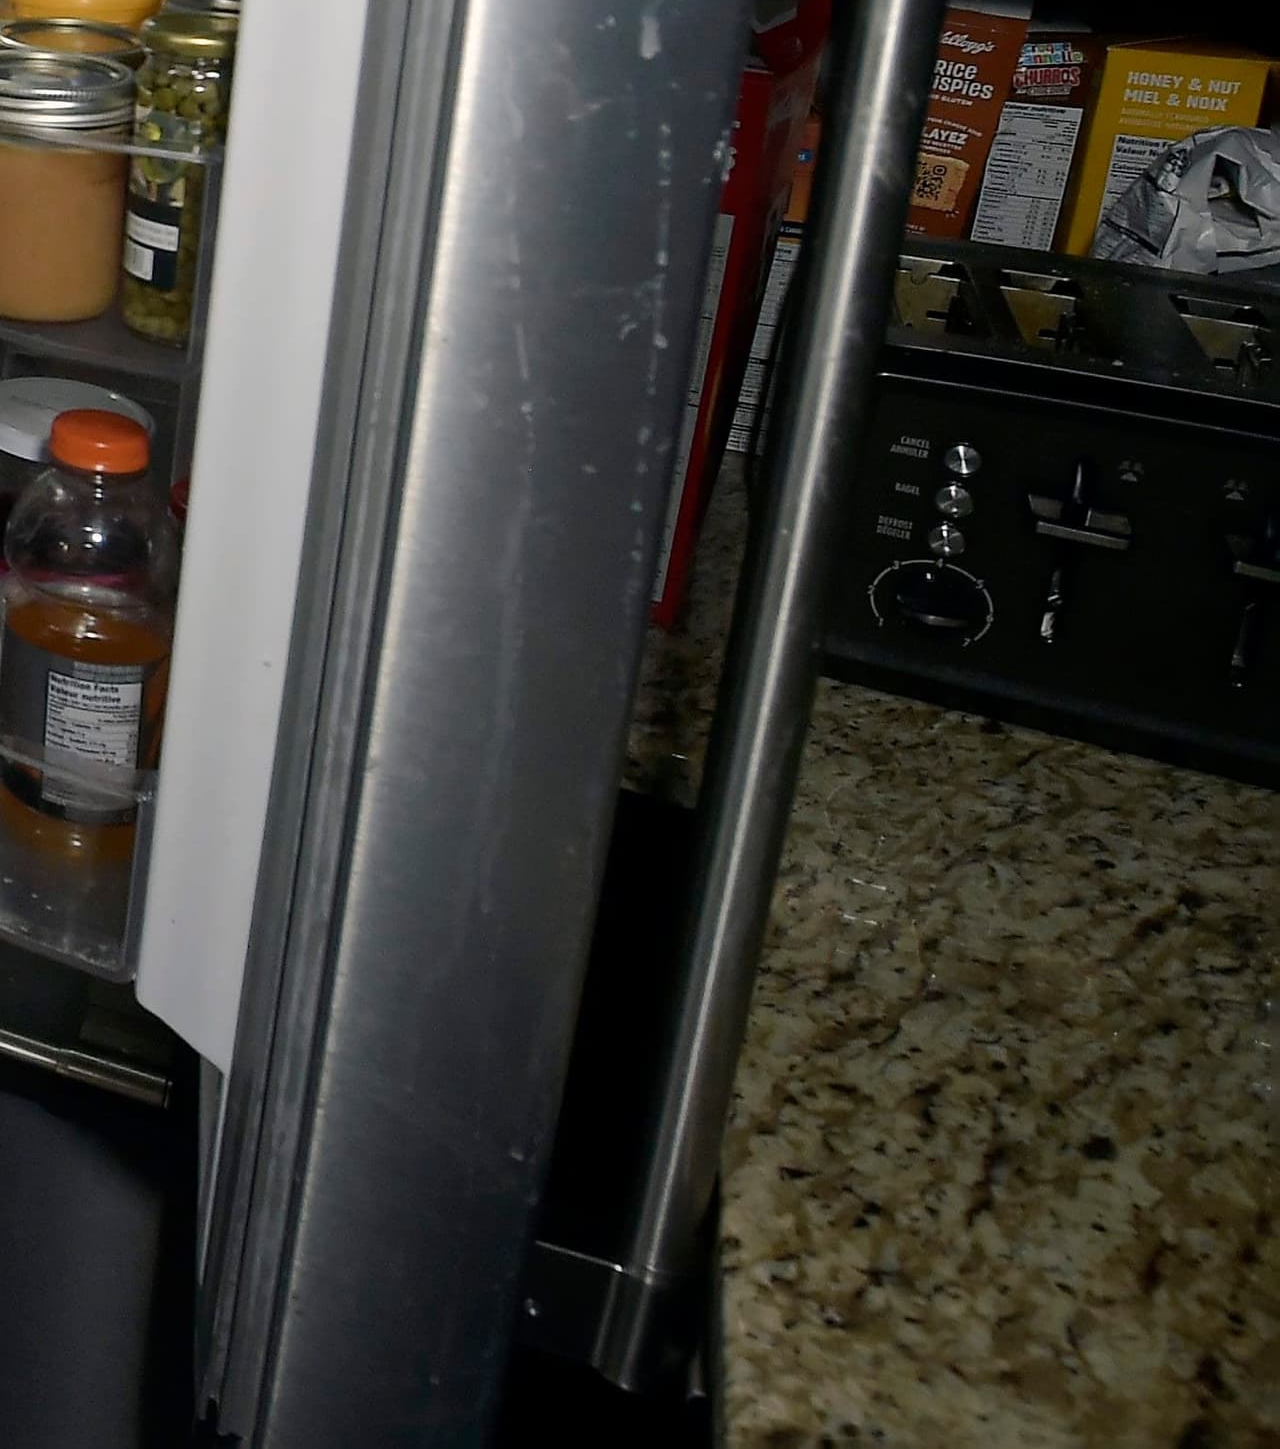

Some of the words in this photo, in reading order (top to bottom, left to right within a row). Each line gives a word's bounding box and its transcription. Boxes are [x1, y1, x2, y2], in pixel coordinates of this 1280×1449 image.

[940, 30, 997, 55] ellogg's
[1018, 51, 1083, 65] annelle
[1126, 70, 1184, 90] HONEY
[1187, 77, 1203, 92] &
[1208, 79, 1242, 95] NUT
[1123, 88, 1161, 105] MIEL
[1166, 92, 1182, 107] &
[1186, 94, 1229, 112] NOIX
[1115, 145, 1146, 156] Valeur
[1118, 136, 1160, 148] Nutrition
[900, 436, 930, 450] CANCEL
[975, 578, 985, 590] 5
[51, 674, 91, 691] Nutrition
[93, 683, 120, 694] Facts
[50, 684, 79, 699] Valeur
[81, 693, 122, 704] nutritive
